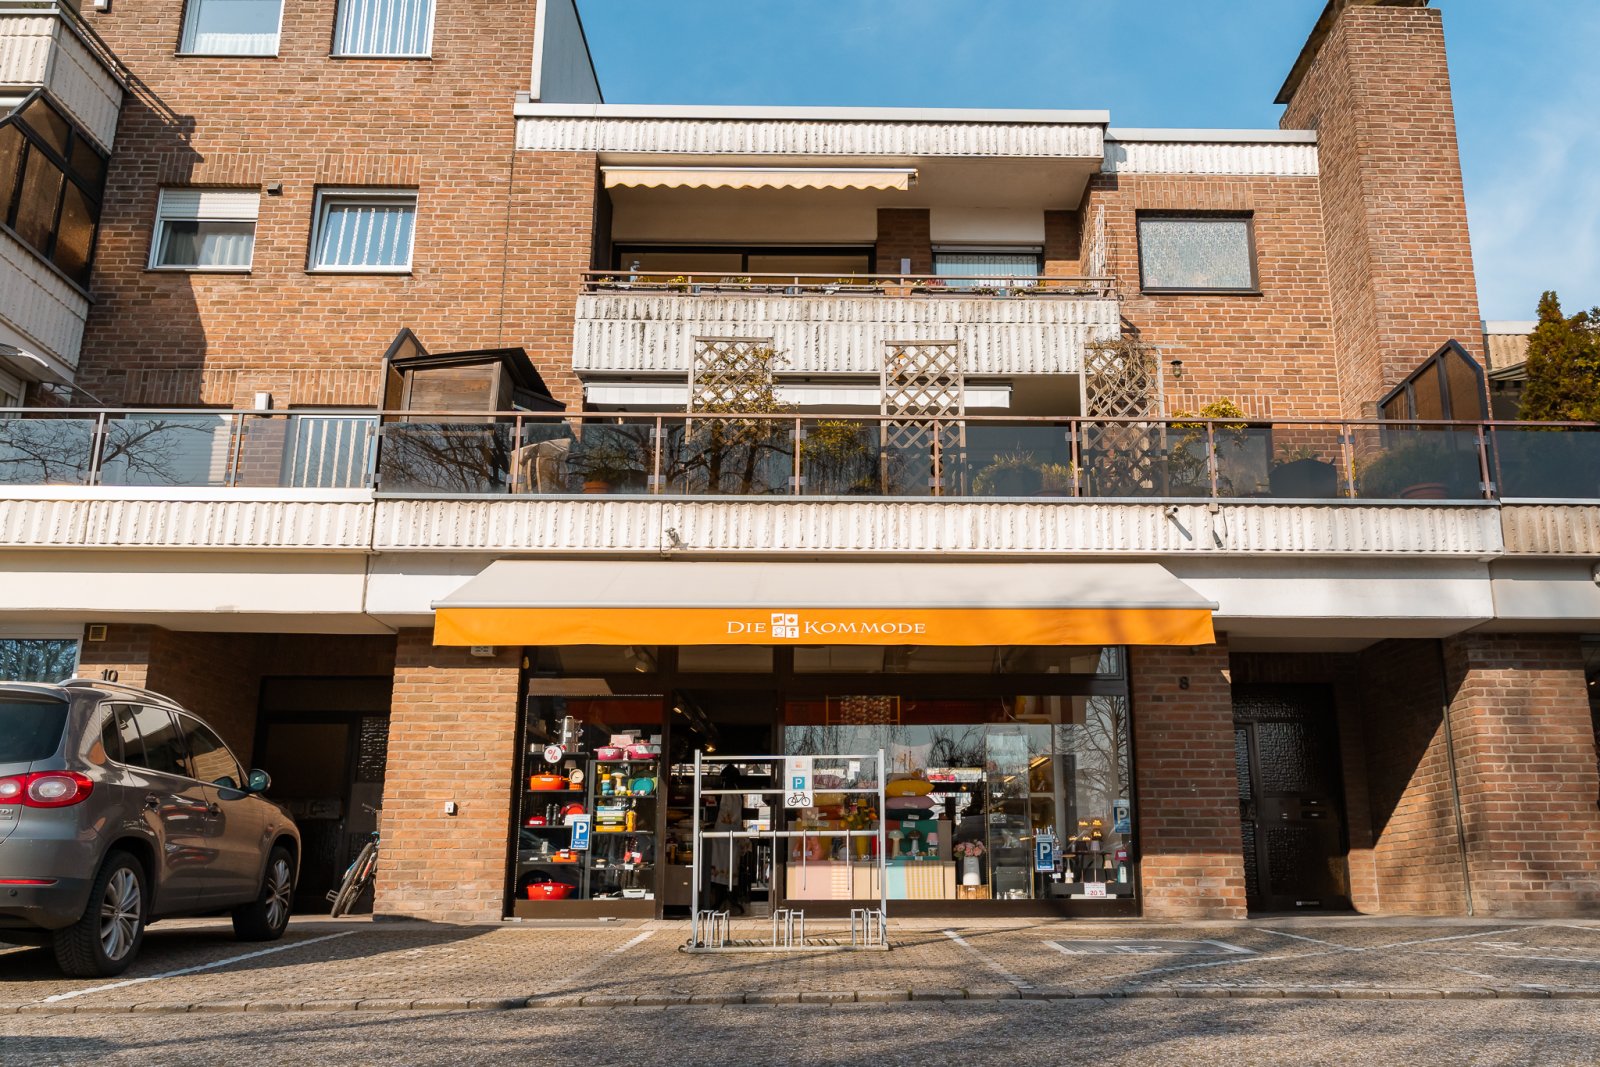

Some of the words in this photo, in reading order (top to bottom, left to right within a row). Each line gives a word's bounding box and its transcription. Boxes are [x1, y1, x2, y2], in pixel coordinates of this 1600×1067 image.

[727, 621, 767, 634] DIE
[804, 621, 926, 635] KOMMODE
[101, 669, 119, 682] 10
[1179, 676, 1190, 690] 8
[795, 778, 803, 789] P
[1117, 807, 1128, 824] P
[575, 822, 588, 839] P
[1040, 842, 1051, 860] P
